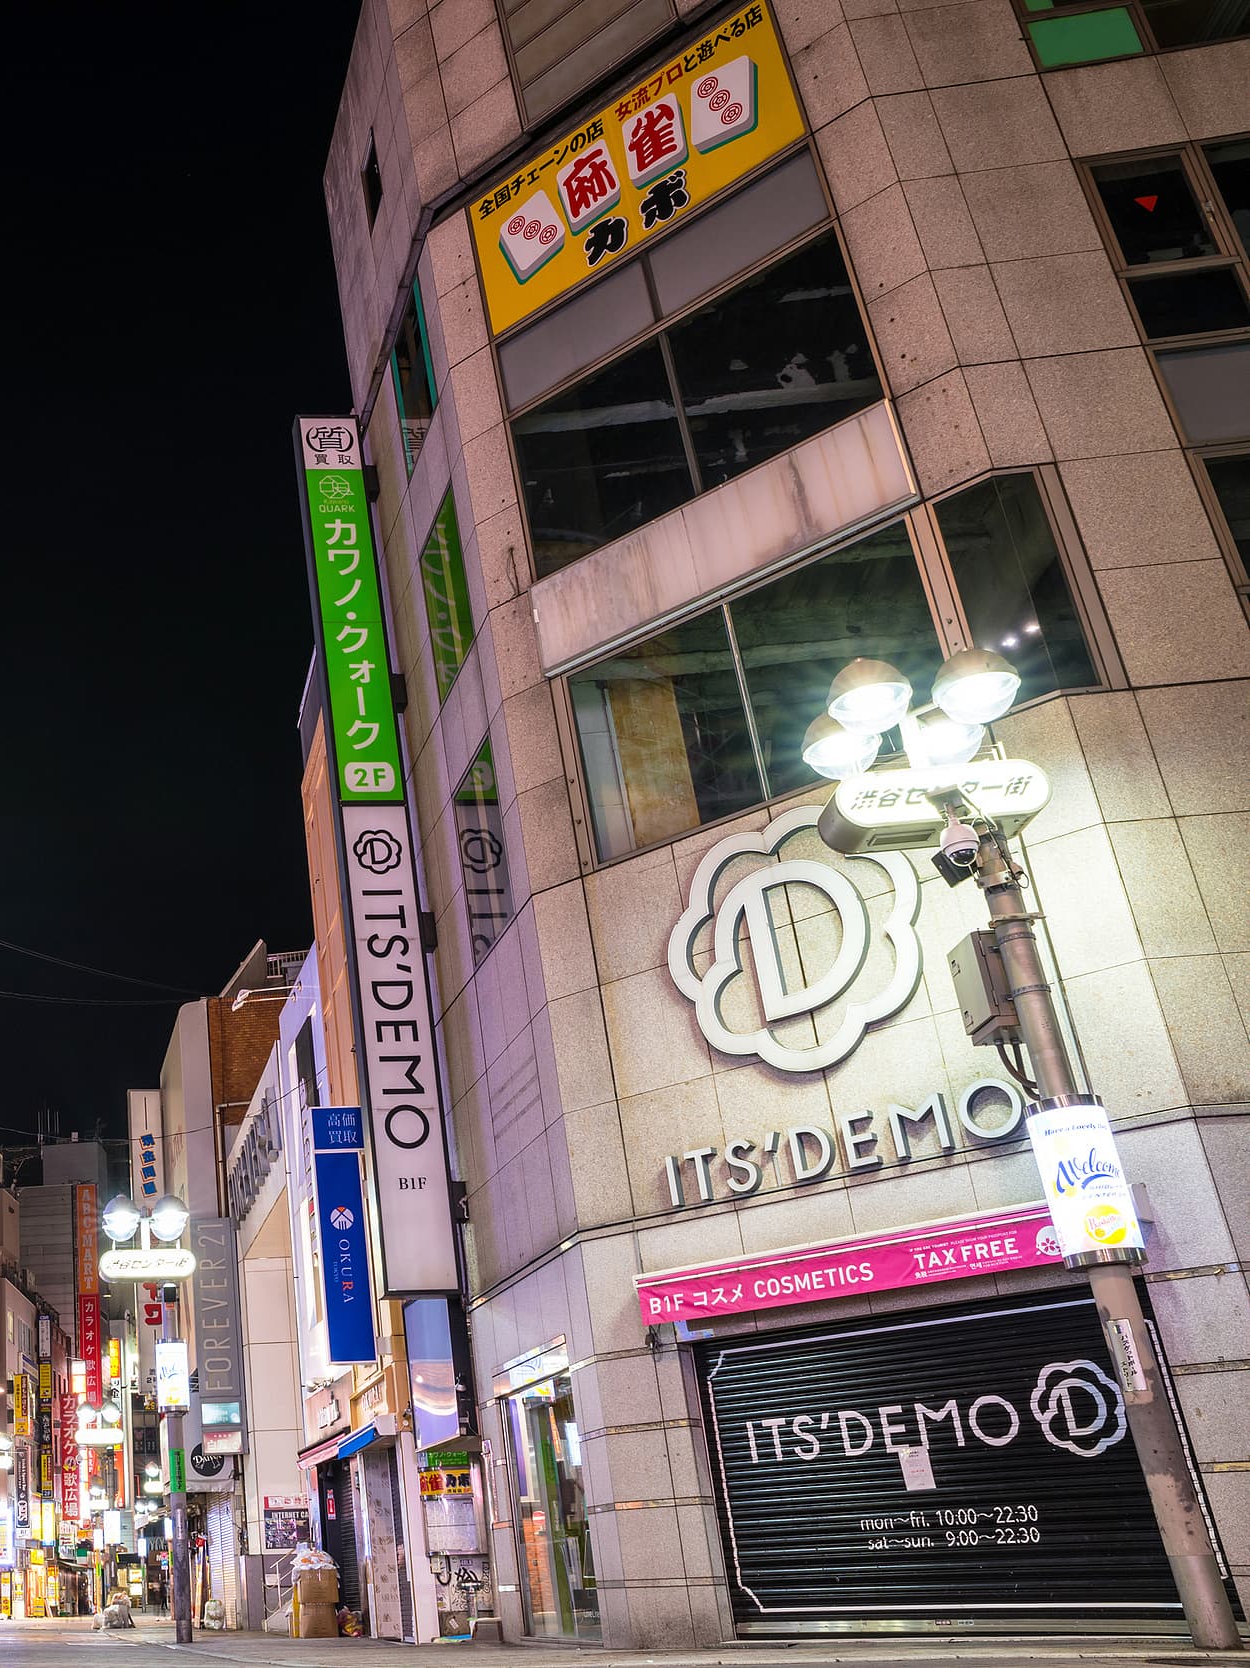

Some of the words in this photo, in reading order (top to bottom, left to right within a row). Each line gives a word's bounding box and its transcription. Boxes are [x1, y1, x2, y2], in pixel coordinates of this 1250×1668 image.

[615, 5, 764, 121] 女流プロと遊べる店
[478, 119, 604, 220] 全国チェーンの店
[563, 104, 678, 218] 麻雀
[314, 454, 355, 465] 買取
[324, 518, 380, 750] カワノ・クォーク
[353, 767, 387, 787] 2F
[851, 775, 1033, 811] 渋谷セター街
[362, 889, 430, 1150] ITS'DEMO
[327, 1113, 356, 1127] 高価
[328, 1130, 357, 1144] 買取
[665, 1077, 1025, 1208] ITS'DEMO
[398, 1177, 427, 1191] B1F
[1056, 1147, 1121, 1193] Welcome
[338, 1239, 354, 1303] OKURA
[913, 1248, 957, 1270] TAX
[960, 1238, 1019, 1262] FREE
[649, 1294, 685, 1316] B1F
[692, 1283, 744, 1308] コスメ
[753, 1262, 875, 1299] COSMETICS
[200, 1259, 234, 1391] FOREVER
[745, 1395, 1020, 1465] ITS'DEMO
[272, 1511, 298, 1519] INTERNET
